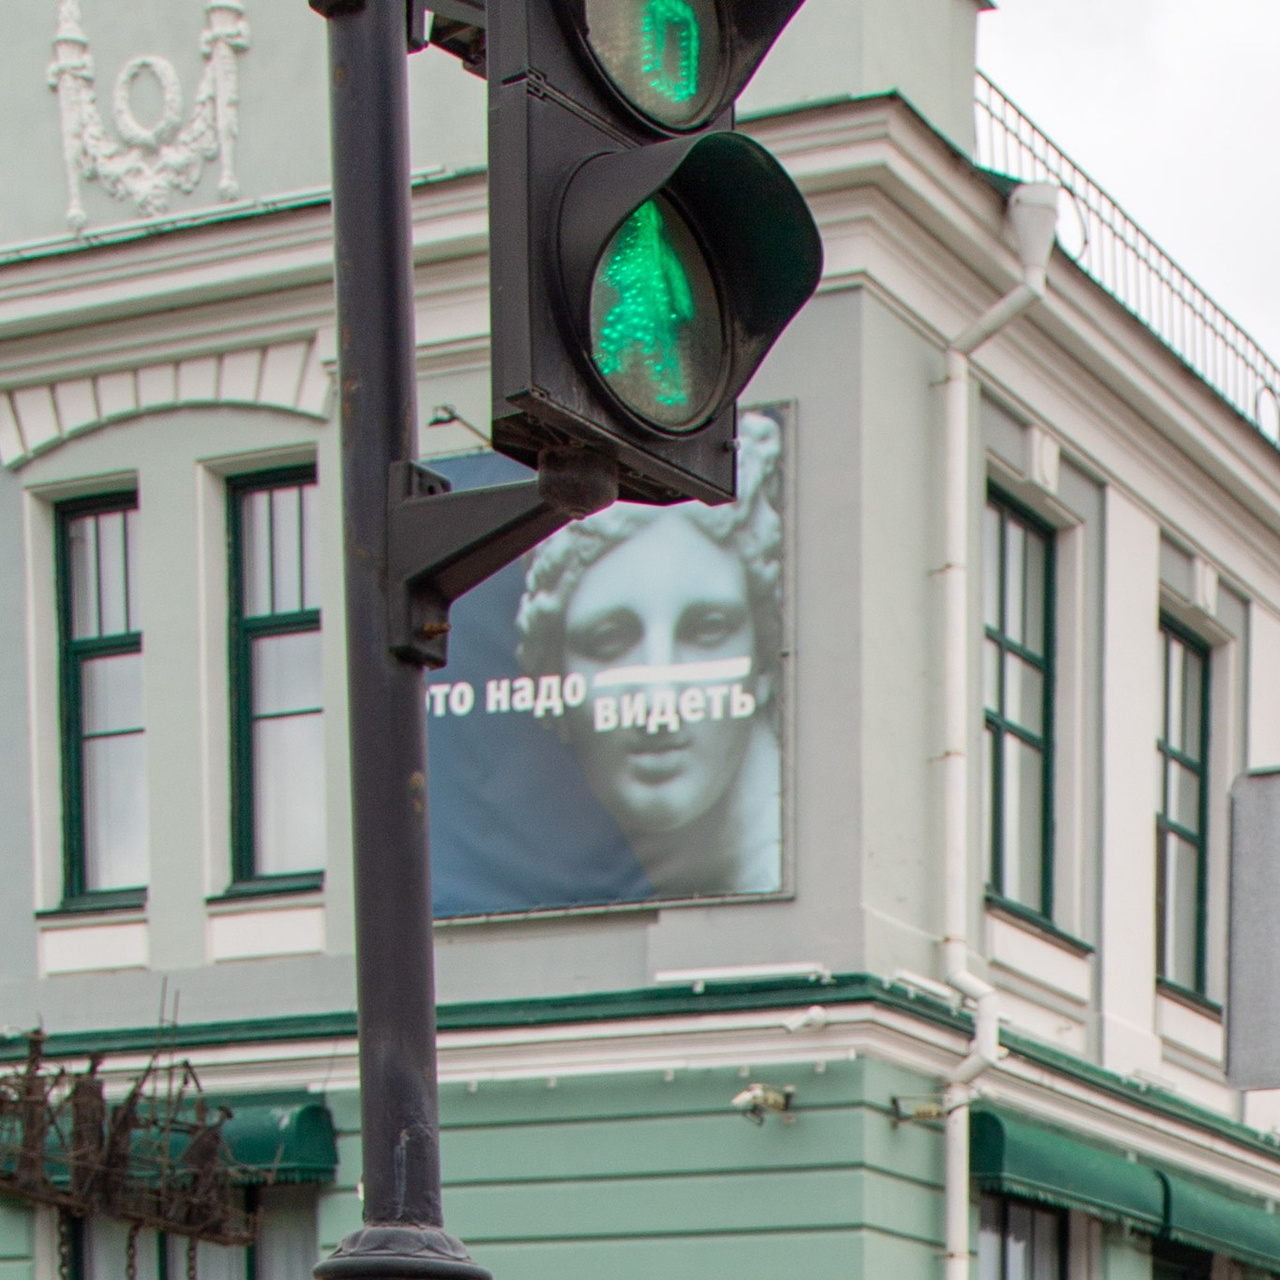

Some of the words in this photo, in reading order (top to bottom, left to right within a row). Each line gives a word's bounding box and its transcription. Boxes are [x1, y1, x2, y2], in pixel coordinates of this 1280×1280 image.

[426, 681, 474, 718] то
[486, 673, 587, 718] надо
[594, 682, 757, 734] видеть
